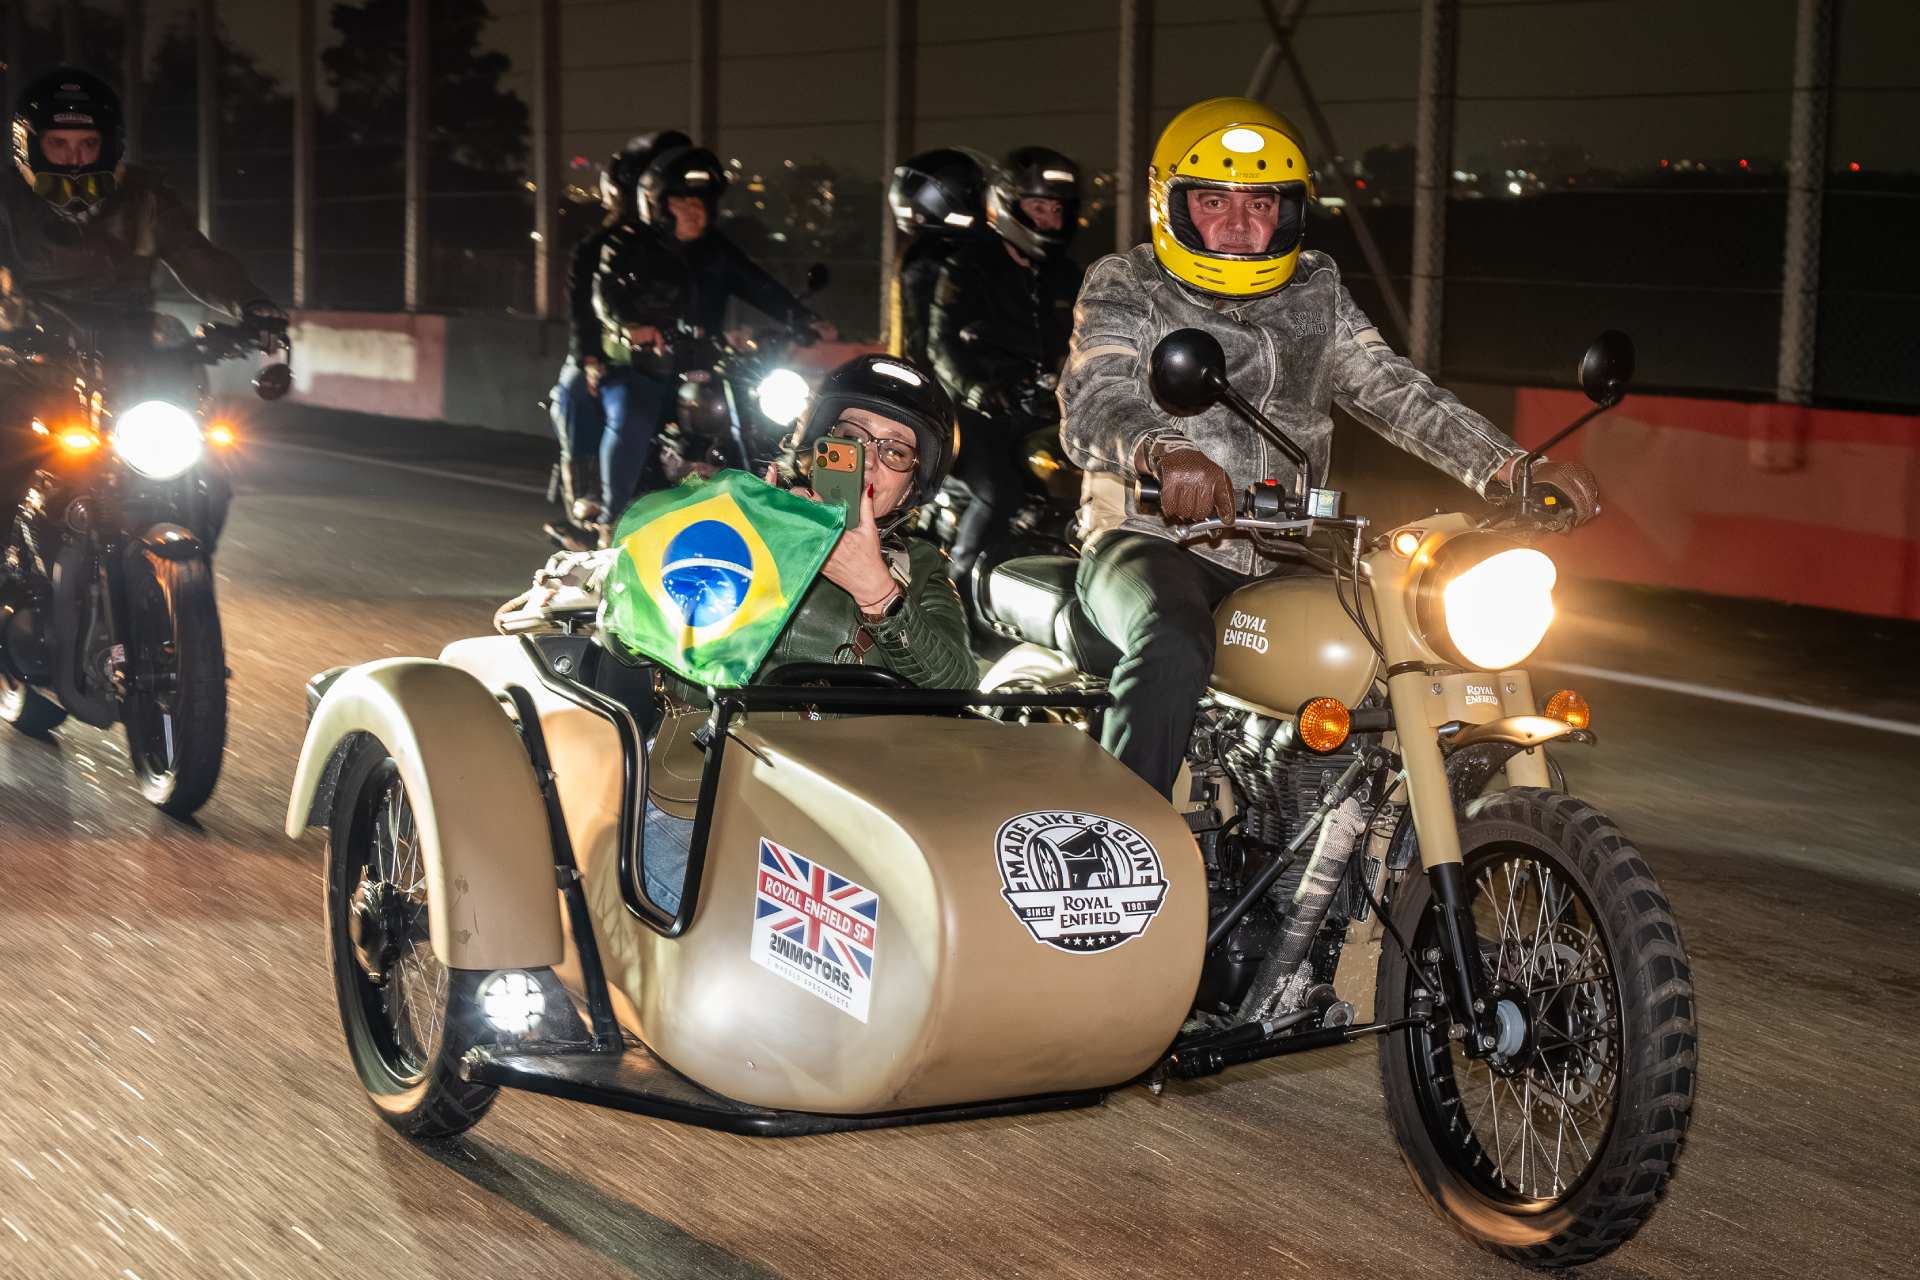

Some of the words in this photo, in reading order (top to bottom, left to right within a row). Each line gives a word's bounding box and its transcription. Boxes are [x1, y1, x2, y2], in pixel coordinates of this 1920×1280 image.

[1230, 610, 1267, 633] ROYAL
[1223, 628, 1269, 654] ENFIELD
[1466, 685, 1494, 695] ROYAL
[1465, 695, 1498, 705] ENFIELD
[1004, 823, 1034, 879] MADE
[1027, 813, 1087, 828] LIKE
[1112, 829, 1155, 872] GUN
[764, 876, 801, 911] ROYAL
[803, 899, 851, 933] ENFIELD
[852, 924, 869, 943] SP
[1026, 907, 1052, 917] SINCE
[1126, 901, 1147, 911] 1901
[1063, 895, 1112, 912] ROYAL
[1060, 911, 1121, 928] ENFIELD
